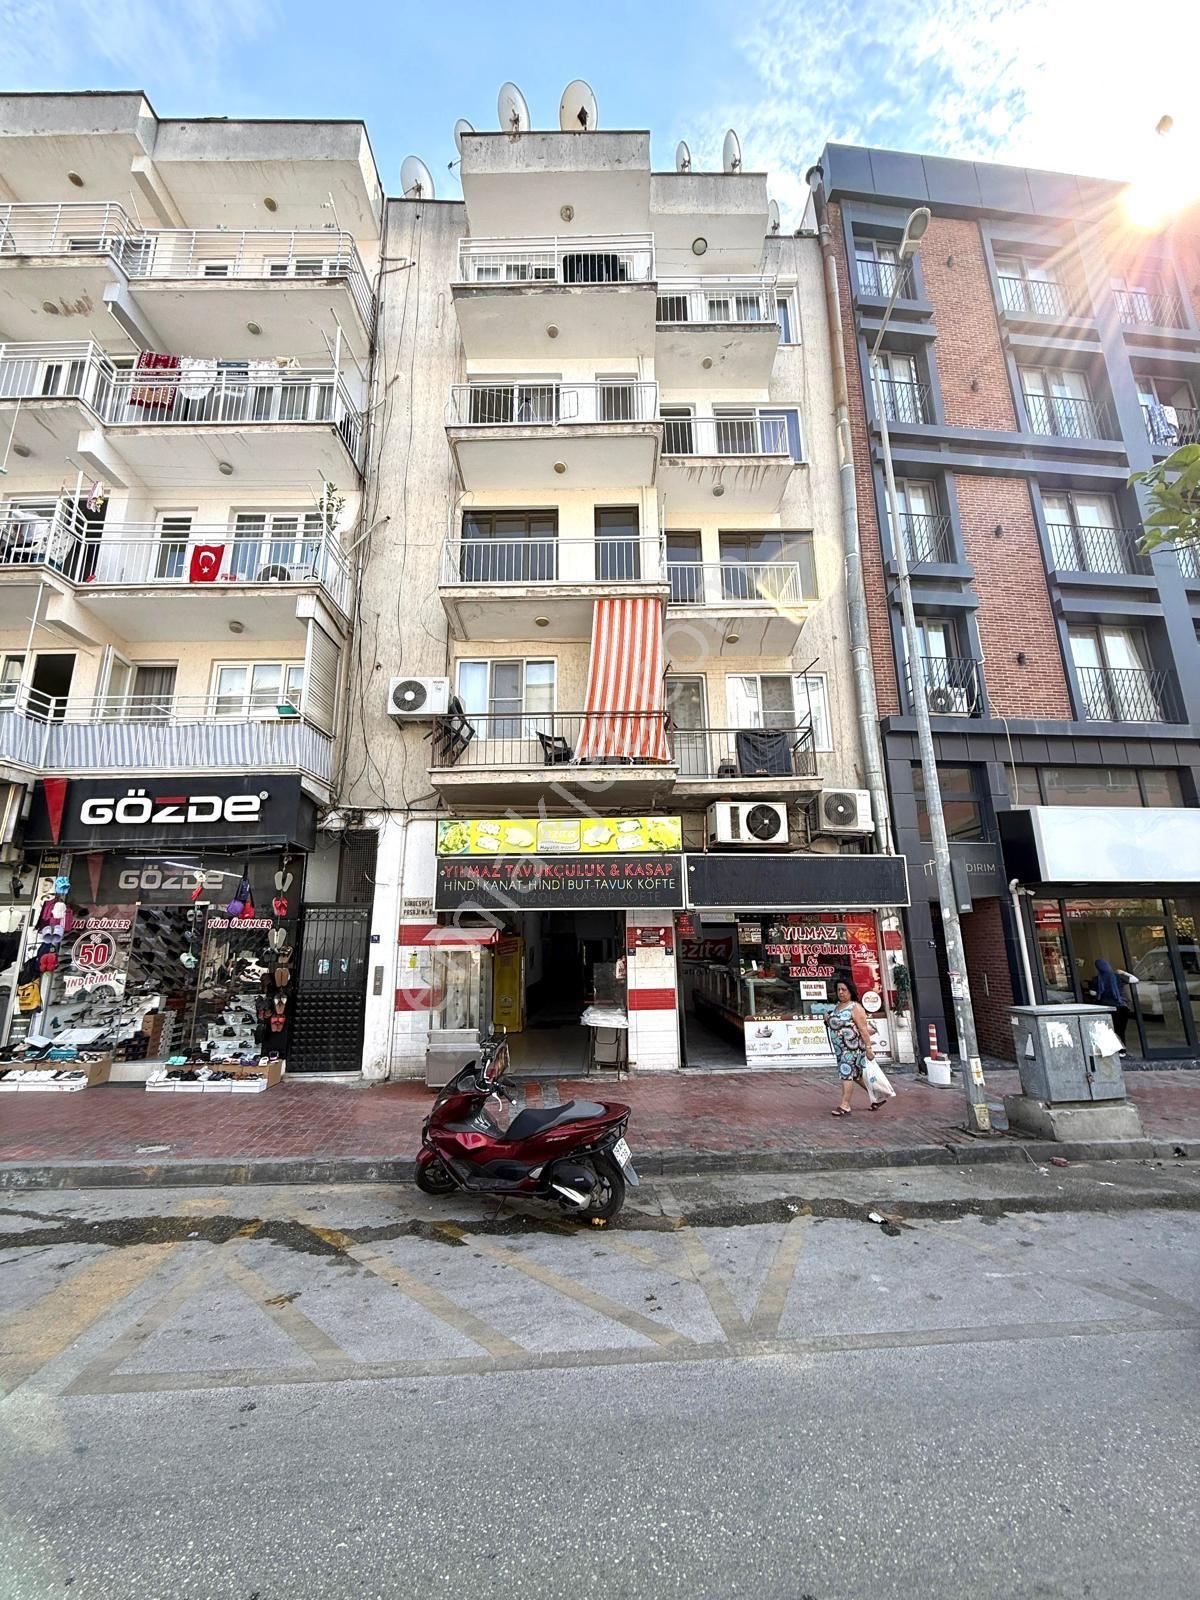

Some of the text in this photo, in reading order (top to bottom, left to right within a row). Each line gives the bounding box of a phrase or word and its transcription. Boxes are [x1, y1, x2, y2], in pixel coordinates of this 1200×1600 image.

[444, 865, 501, 878] YILMAZ
[610, 864, 620, 876] &
[624, 863, 673, 876] KASAP
[637, 877, 675, 889] KÖFTE
[86, 917, 132, 929] ÜRÜNLER
[207, 918, 274, 929] TÜM ÜRÜNLER
[781, 926, 838, 941] YILMAZ
[79, 943, 109, 967] 50
[806, 956, 819, 967] &
[788, 966, 835, 978] KASAP
